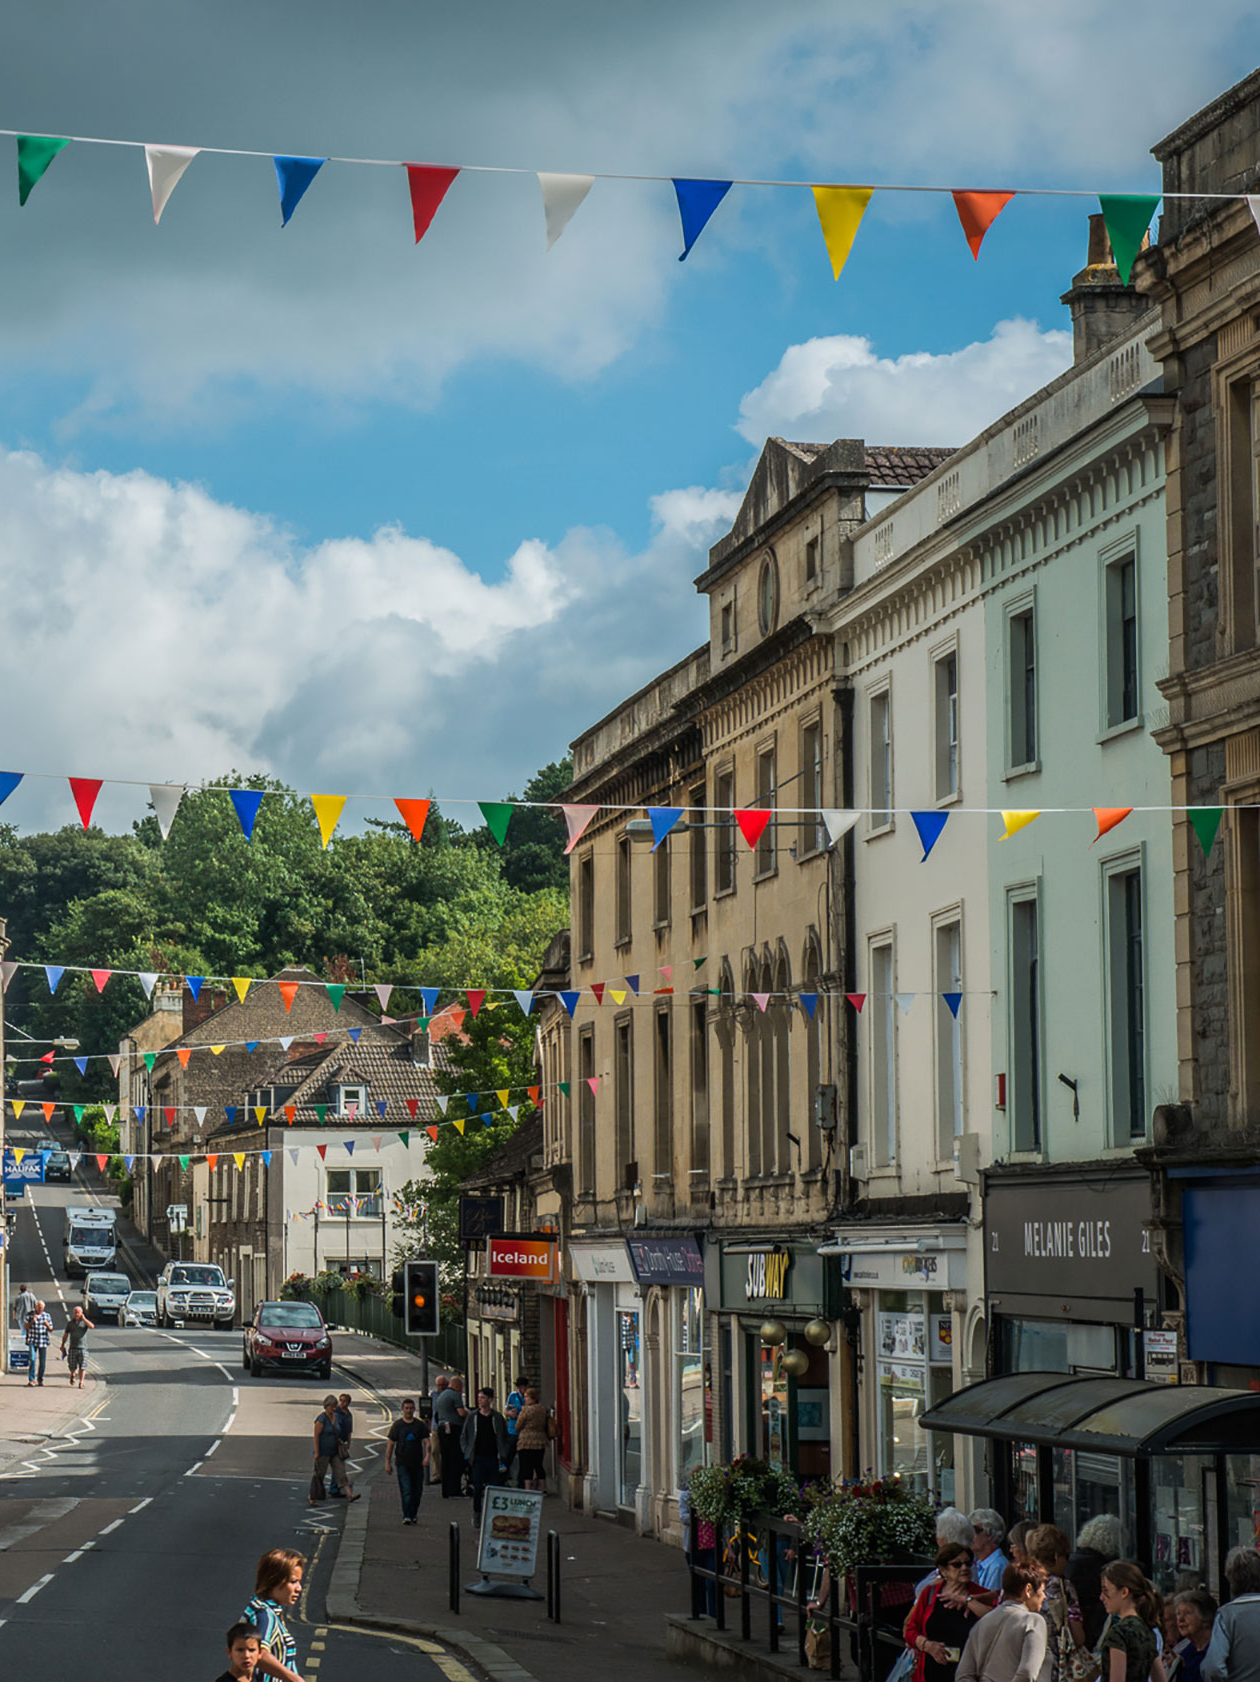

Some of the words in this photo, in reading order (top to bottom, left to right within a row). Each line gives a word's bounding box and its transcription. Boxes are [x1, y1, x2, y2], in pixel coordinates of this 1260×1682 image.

[4, 1165, 42, 1174] HALIFAX
[1024, 1221, 1074, 1257] MELANIE
[1078, 1221, 1111, 1258] GILES
[1141, 1230, 1151, 1253] 21
[492, 1251, 549, 1265] Iceland
[745, 1249, 790, 1299] SUBWAY
[492, 1496, 509, 1511] £3
